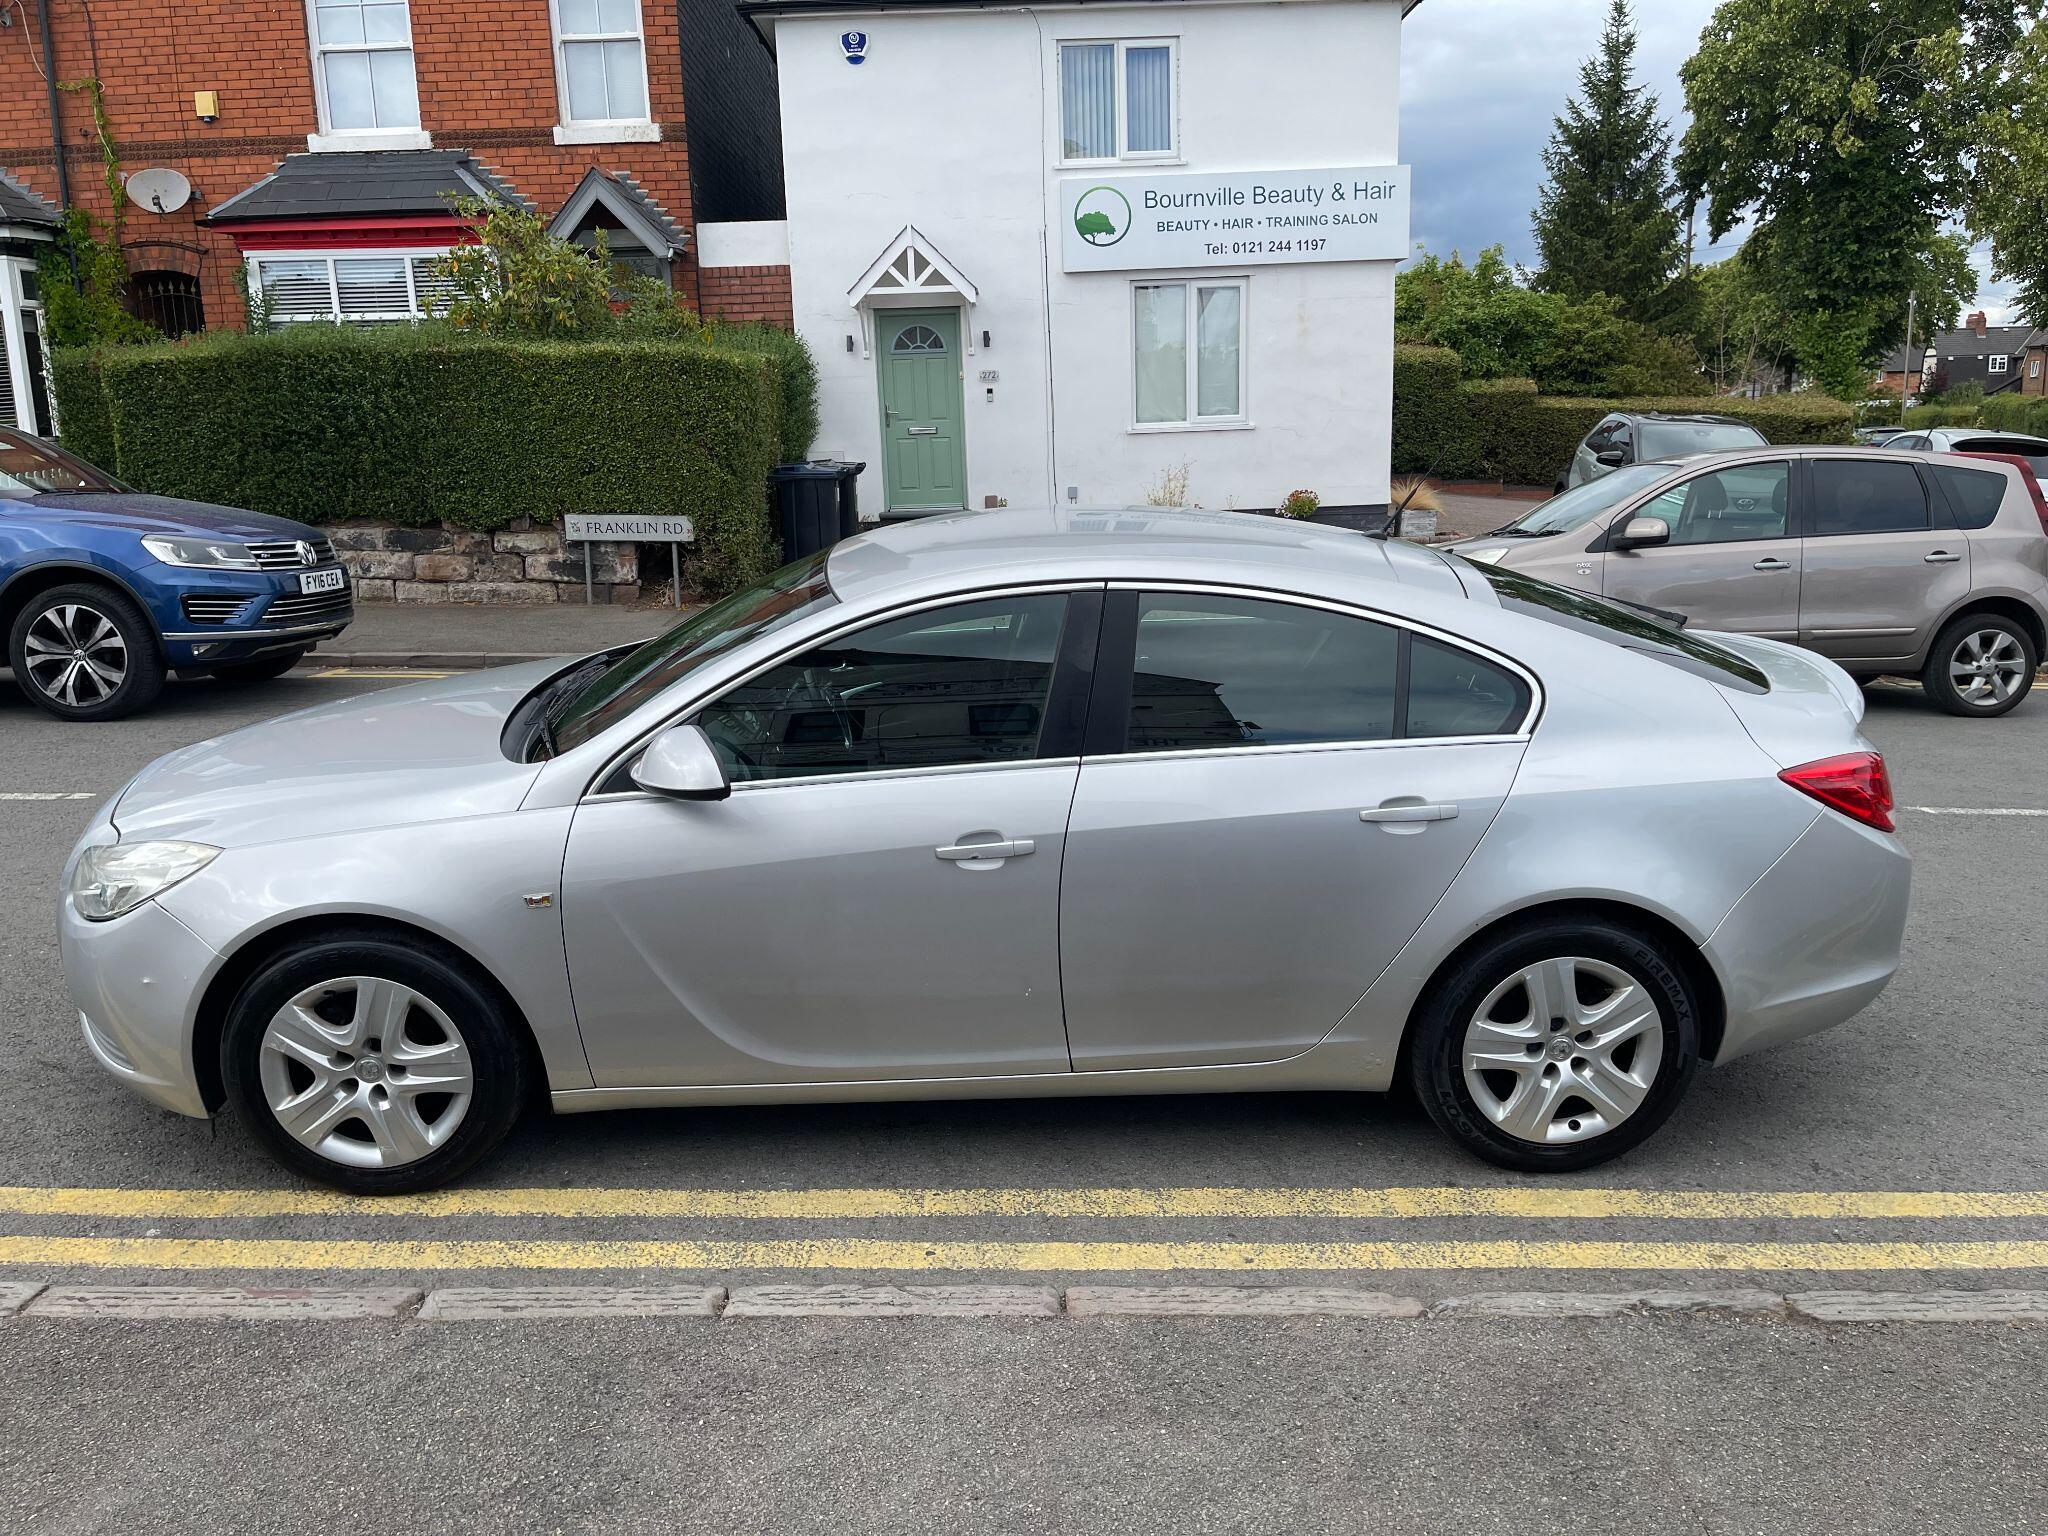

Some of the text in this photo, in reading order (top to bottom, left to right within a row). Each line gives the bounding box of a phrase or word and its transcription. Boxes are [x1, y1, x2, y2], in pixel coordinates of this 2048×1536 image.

[1144, 180, 1396, 209] Bournville Beauty & Hair
[1157, 212, 1378, 232] BEAUTY HAIR TRAINING SALON
[1204, 238, 1327, 255] Tel: 0121 244 1197
[586, 522, 658, 534] FRANKLIN
[1633, 950, 1691, 1021] FIREMAX
